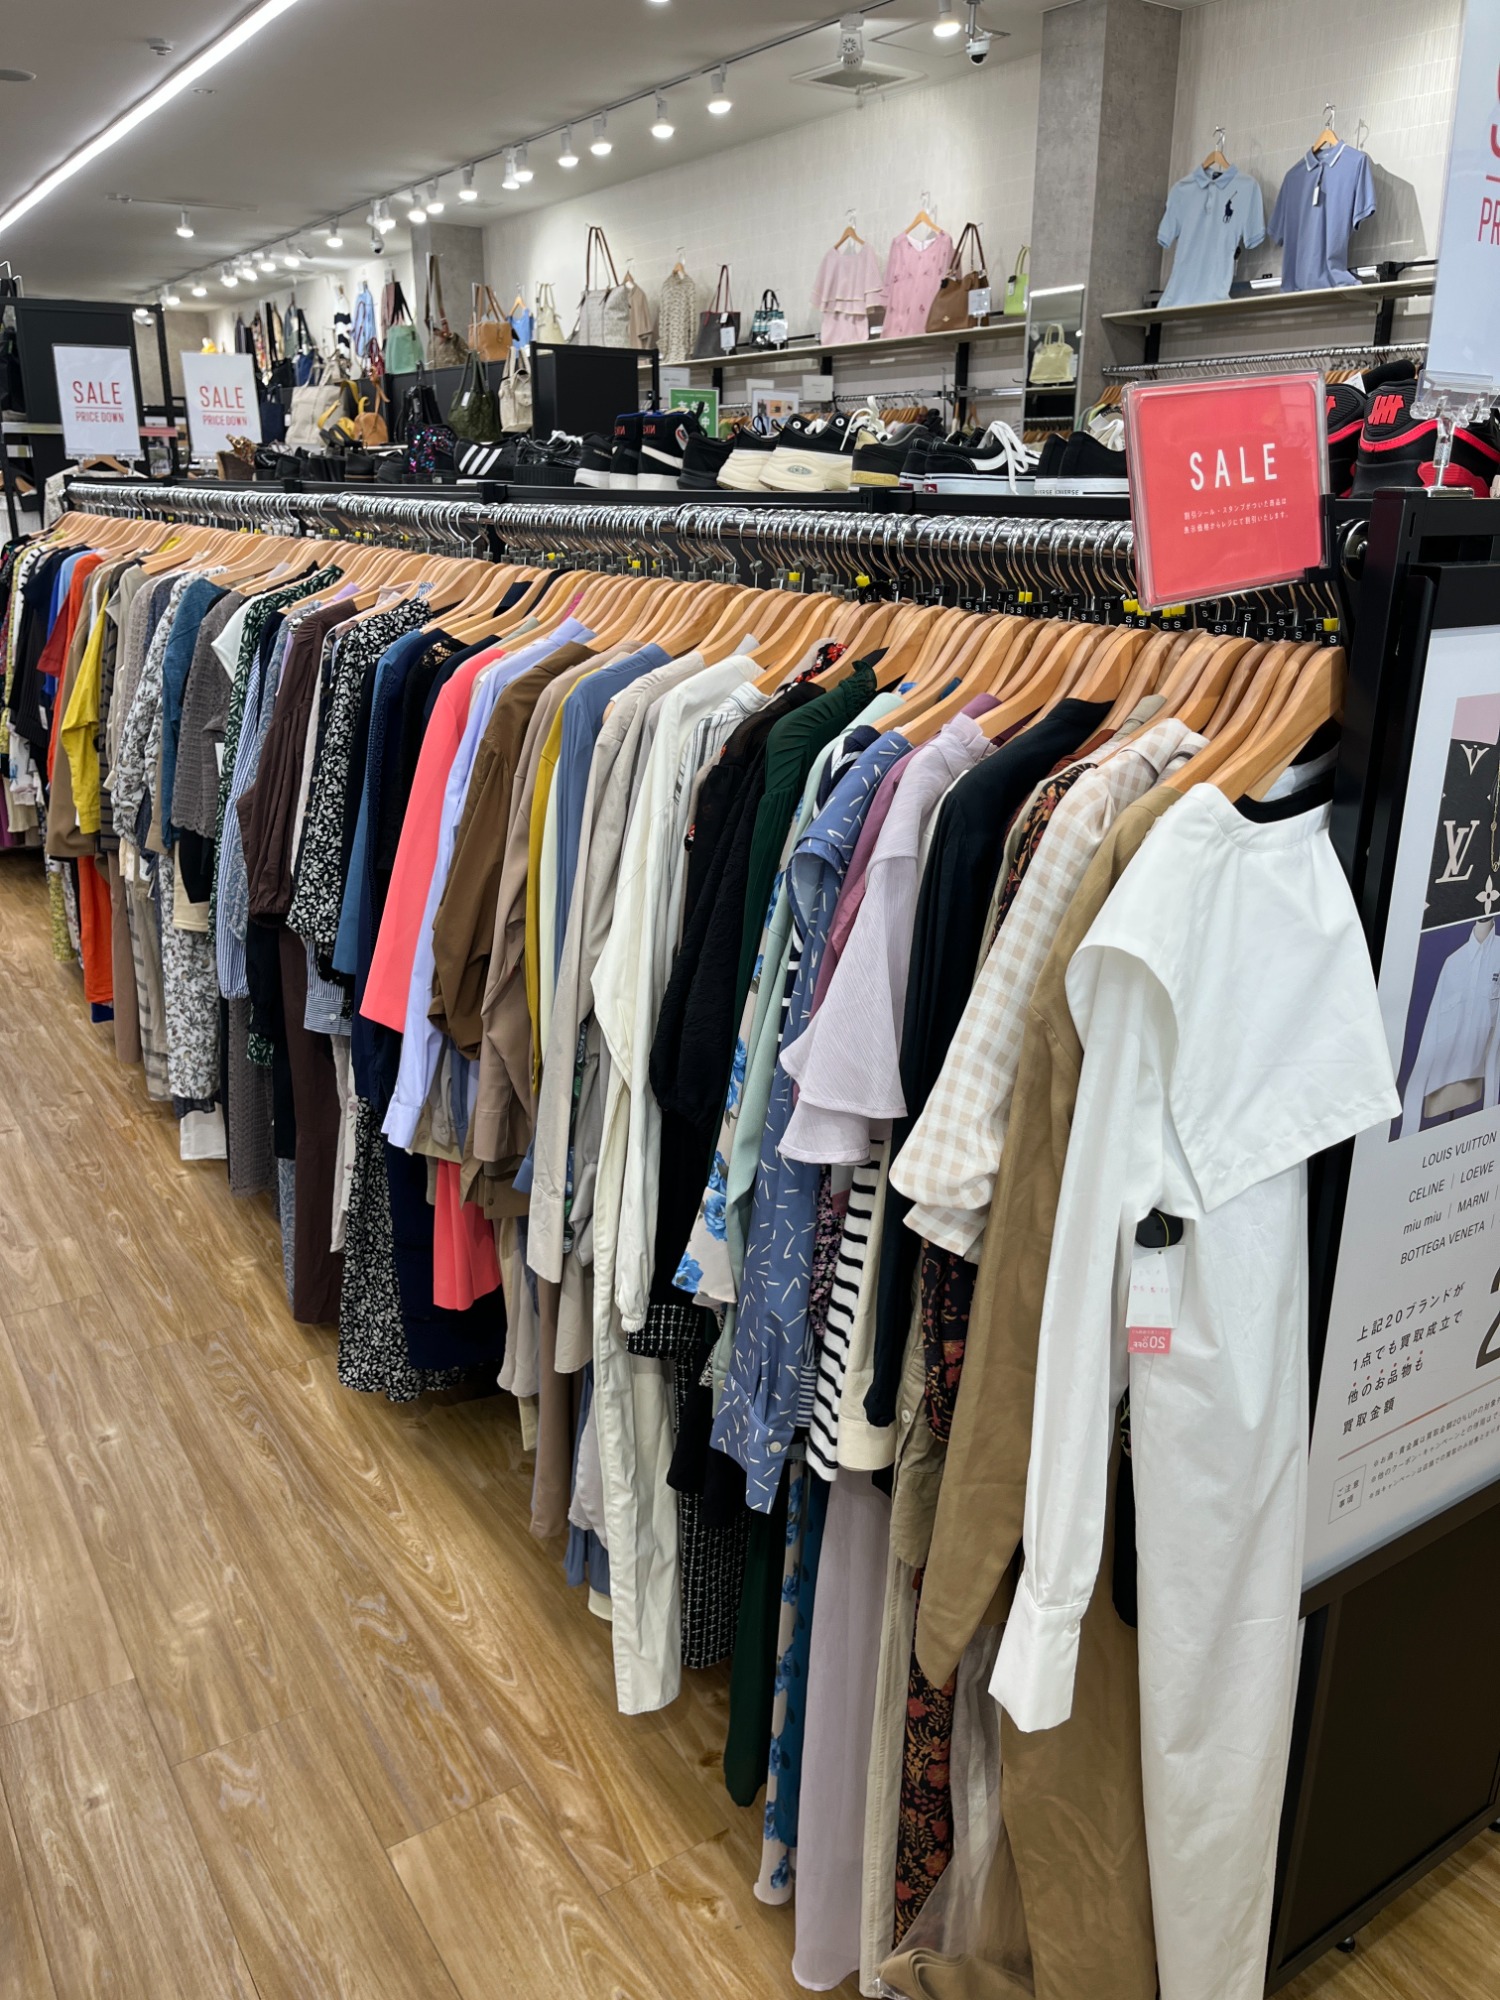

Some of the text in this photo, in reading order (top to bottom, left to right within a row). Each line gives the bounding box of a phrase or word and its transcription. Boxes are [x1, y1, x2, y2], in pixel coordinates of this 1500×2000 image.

[72, 380, 122, 404] SALE
[199, 385, 245, 408] SALE
[75, 411, 124, 423] PRICE DOWN
[202, 415, 248, 426] PRICE DOWN
[1189, 443, 1278, 491] SALE
[1435, 820, 1480, 883] LV
[1422, 1131, 1497, 1168] LOUIS VUITTON
[1409, 1160, 1494, 1203] CELINE LOEWE
[1403, 1190, 1489, 1235] miu miu MARNI
[1400, 1220, 1485, 1265] BOTTEGA VENETA
[1356, 1281, 1466, 1342] 上記20ブランドが
[1352, 1309, 1463, 1371] 1点でも買取成立で
[1347, 1356, 1424, 1405] 他のお品物も
[1342, 1396, 1396, 1435] 買取金額
